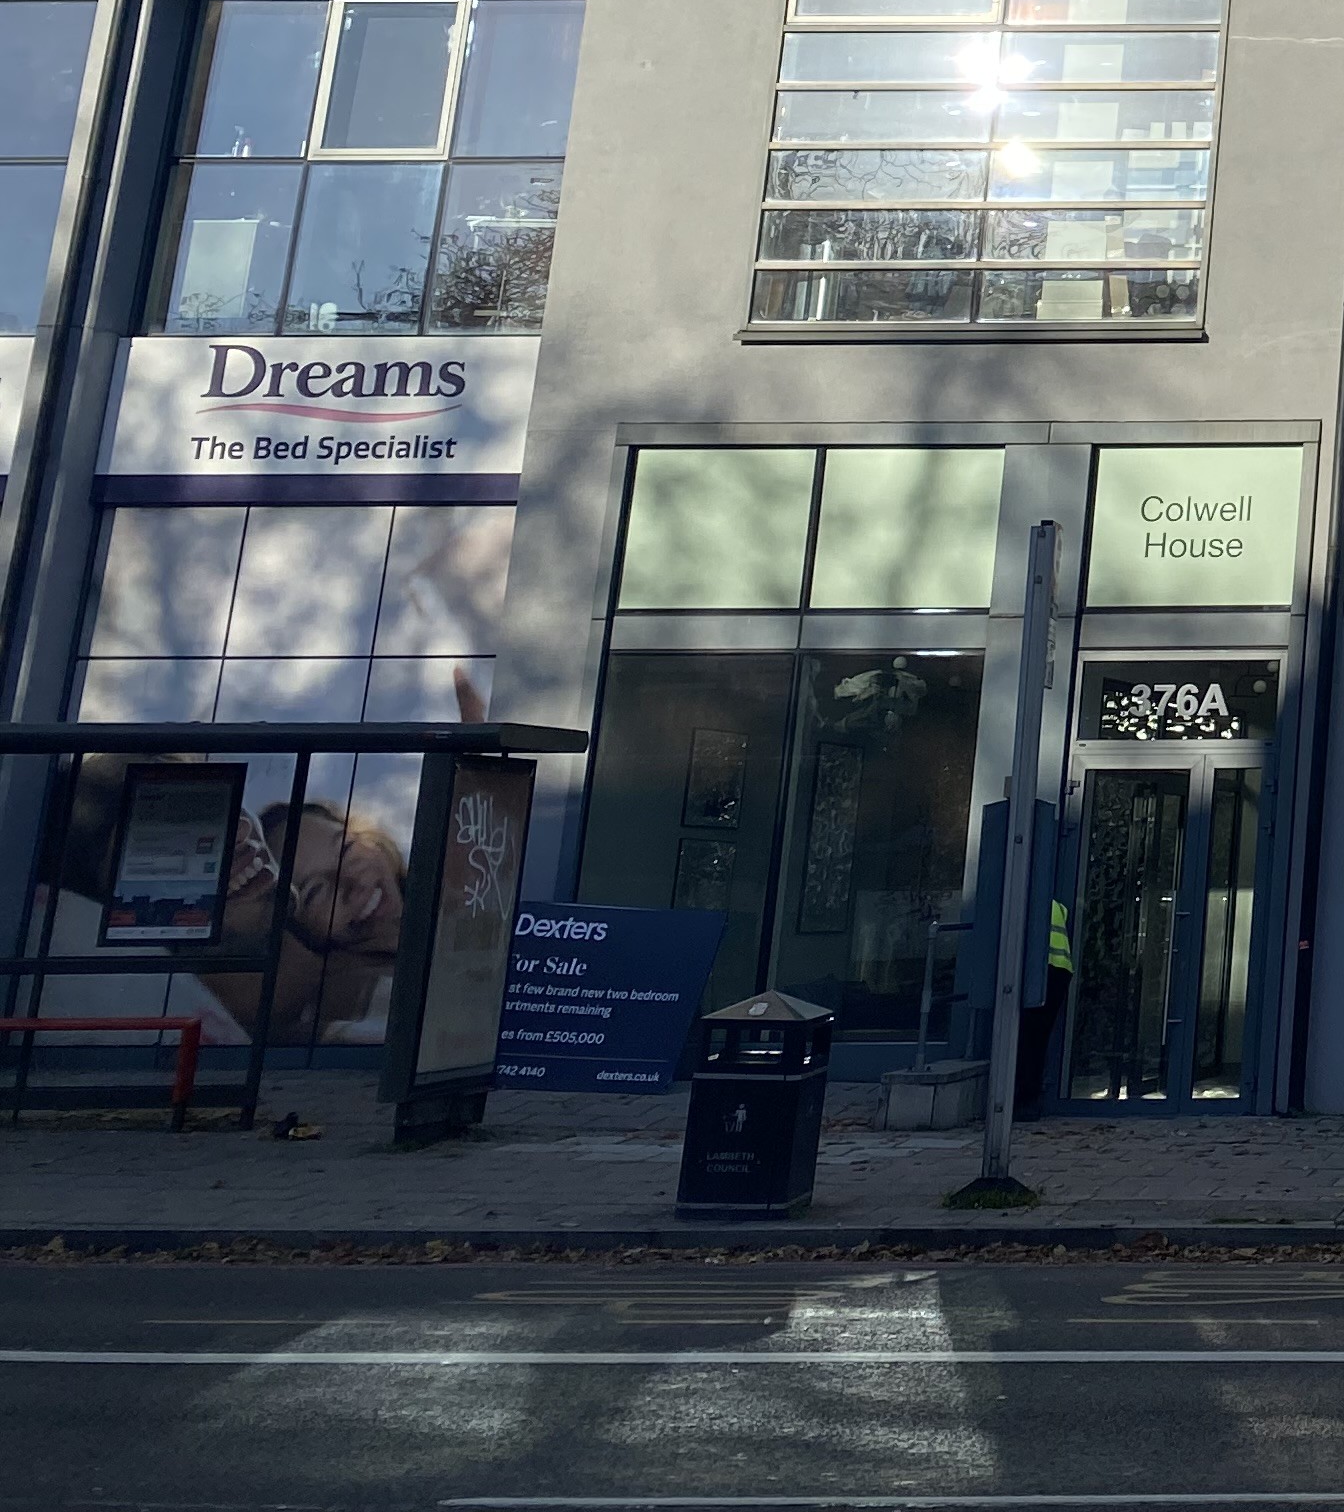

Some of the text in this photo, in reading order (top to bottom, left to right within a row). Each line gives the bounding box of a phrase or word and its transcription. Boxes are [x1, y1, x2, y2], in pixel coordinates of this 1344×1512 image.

[201, 344, 466, 398] Dreams
[191, 434, 457, 466] The Bed Specialist
[1140, 495, 1252, 522] Colwell
[1144, 532, 1243, 558] House
[1129, 683, 1229, 717] 376A
[515, 913, 608, 941] Dexters
[543, 956, 587, 976] Sale
[508, 982, 679, 1002] st few brand new two bedroom
[505, 1000, 612, 1018] rtments remaining
[516, 1029, 544, 1041] from
[544, 1031, 605, 1045] £505,000
[497, 1065, 546, 1077] 742 4140
[596, 1070, 660, 1082] dexters.co.uk
[706, 1164, 753, 1173] COUNCIL
